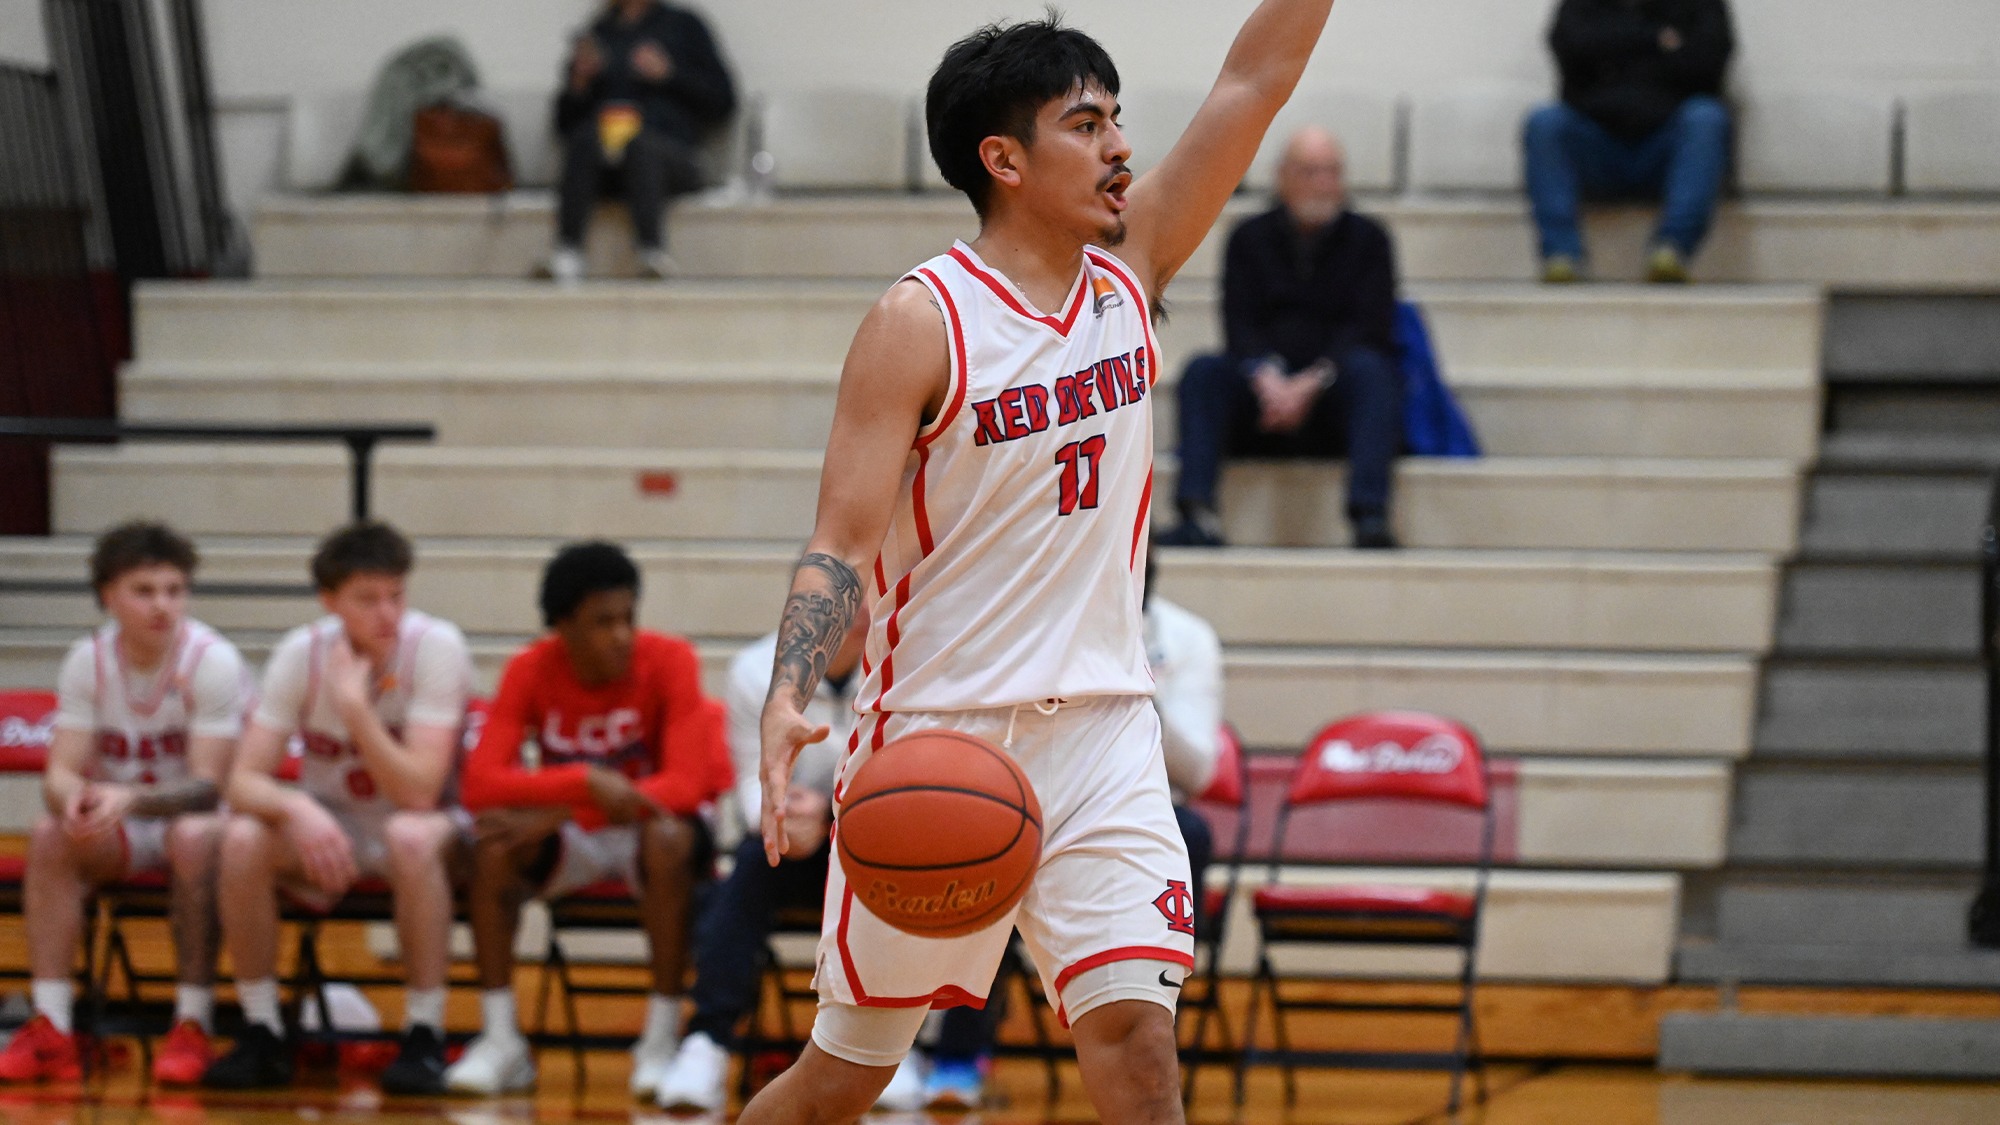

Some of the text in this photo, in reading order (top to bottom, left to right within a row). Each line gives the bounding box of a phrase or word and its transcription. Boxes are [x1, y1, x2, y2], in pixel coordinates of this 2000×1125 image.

[971, 346, 1147, 447] RED DEVILS
[1054, 433, 1107, 516] 11
